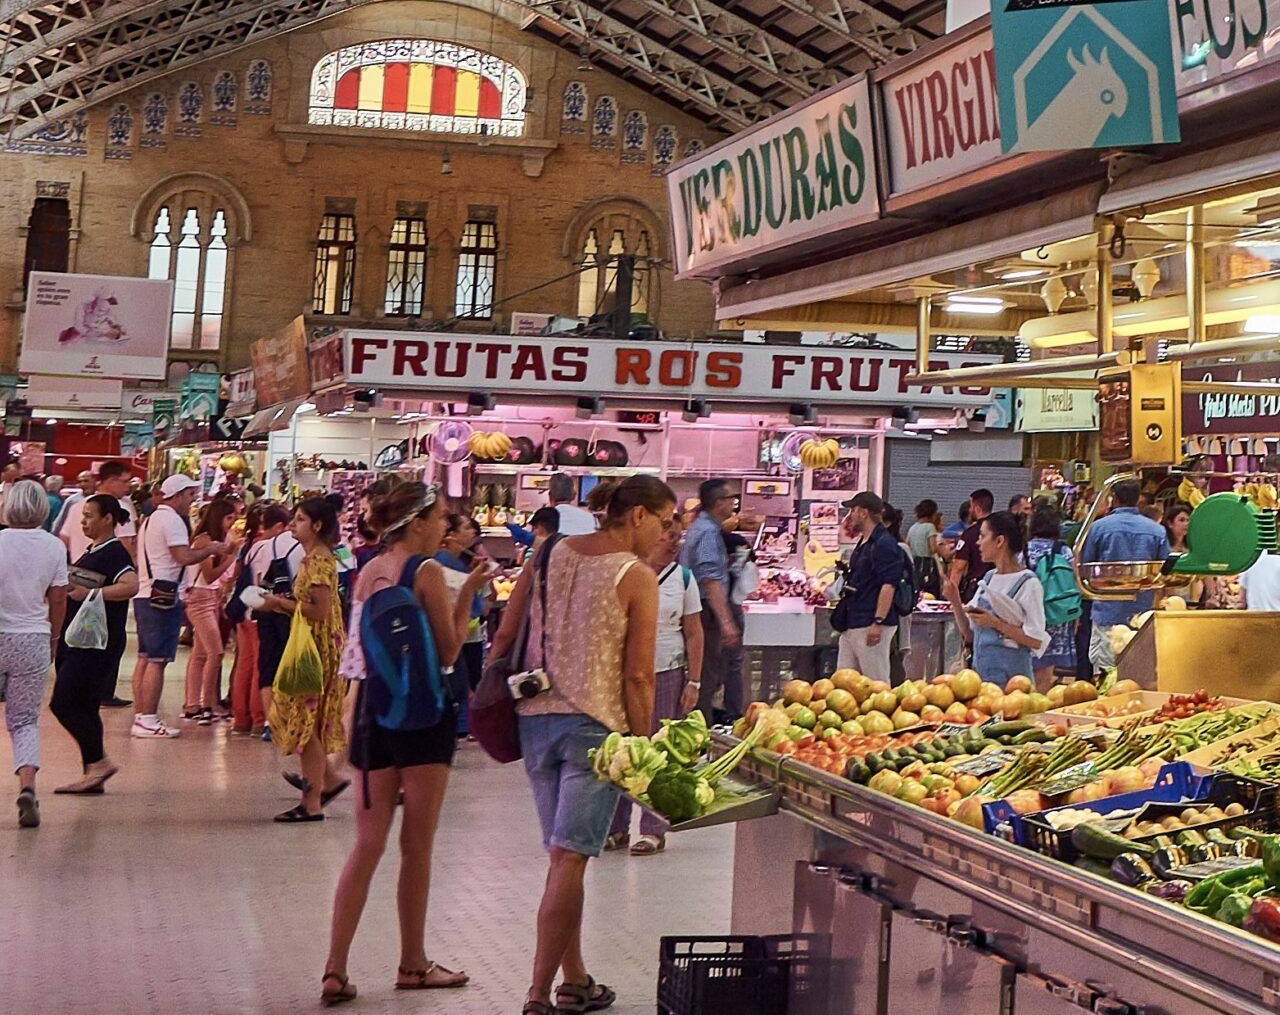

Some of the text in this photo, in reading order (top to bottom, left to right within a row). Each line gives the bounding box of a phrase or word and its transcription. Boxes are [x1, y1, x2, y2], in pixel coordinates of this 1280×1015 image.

[679, 98, 866, 258] VERDURAS
[351, 338, 590, 383] FRUTAS
[614, 347, 744, 390] ROS
